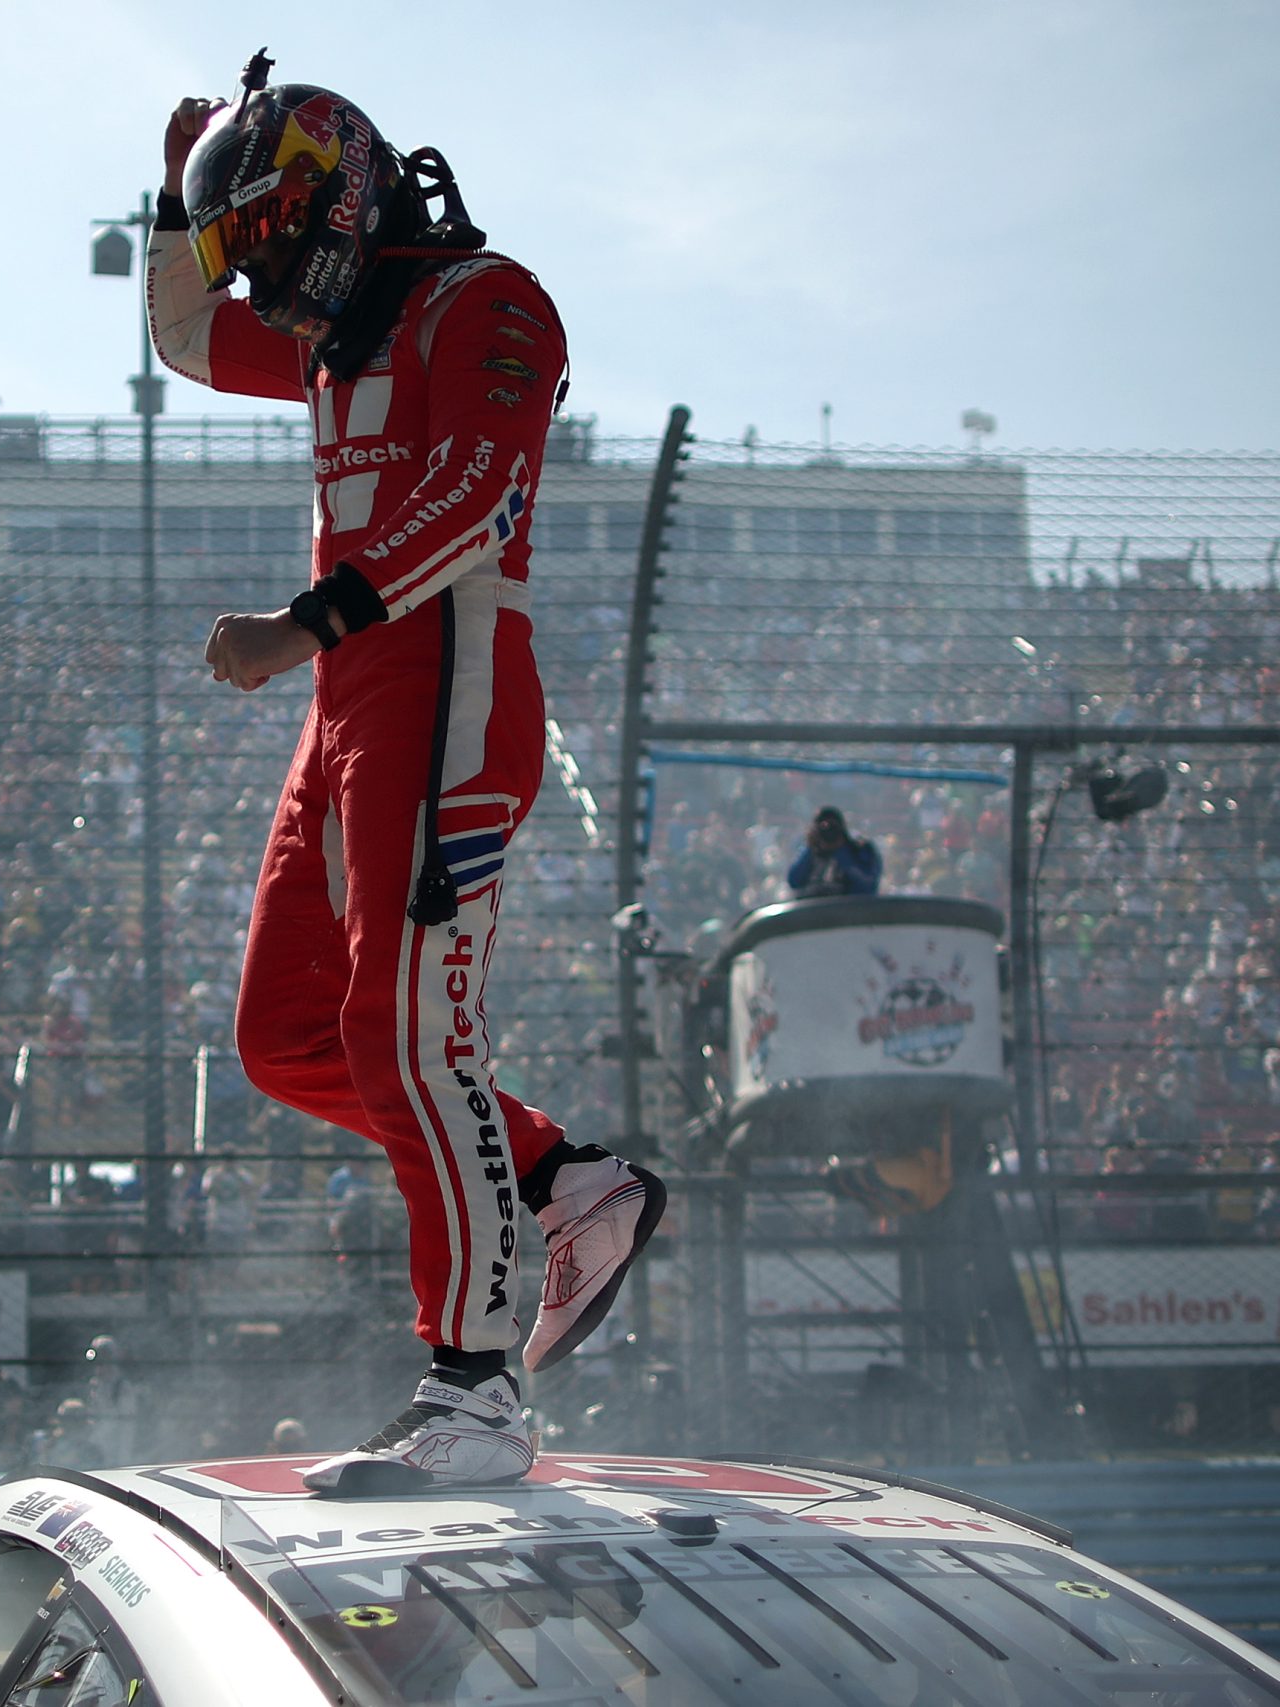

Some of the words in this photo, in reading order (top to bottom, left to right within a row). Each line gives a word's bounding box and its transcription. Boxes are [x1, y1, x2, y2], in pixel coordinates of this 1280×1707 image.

[238, 180, 271, 200] Group
[146, 266, 157, 310] GIVES
[300, 246, 327, 294] Safety
[311, 249, 338, 299] Culture
[441, 933, 517, 1317] WeatherTech
[1082, 1287, 1266, 1326] Sahlen's
[98, 1554, 152, 1609] SIEMENS
[336, 1557, 547, 1599] VAN
